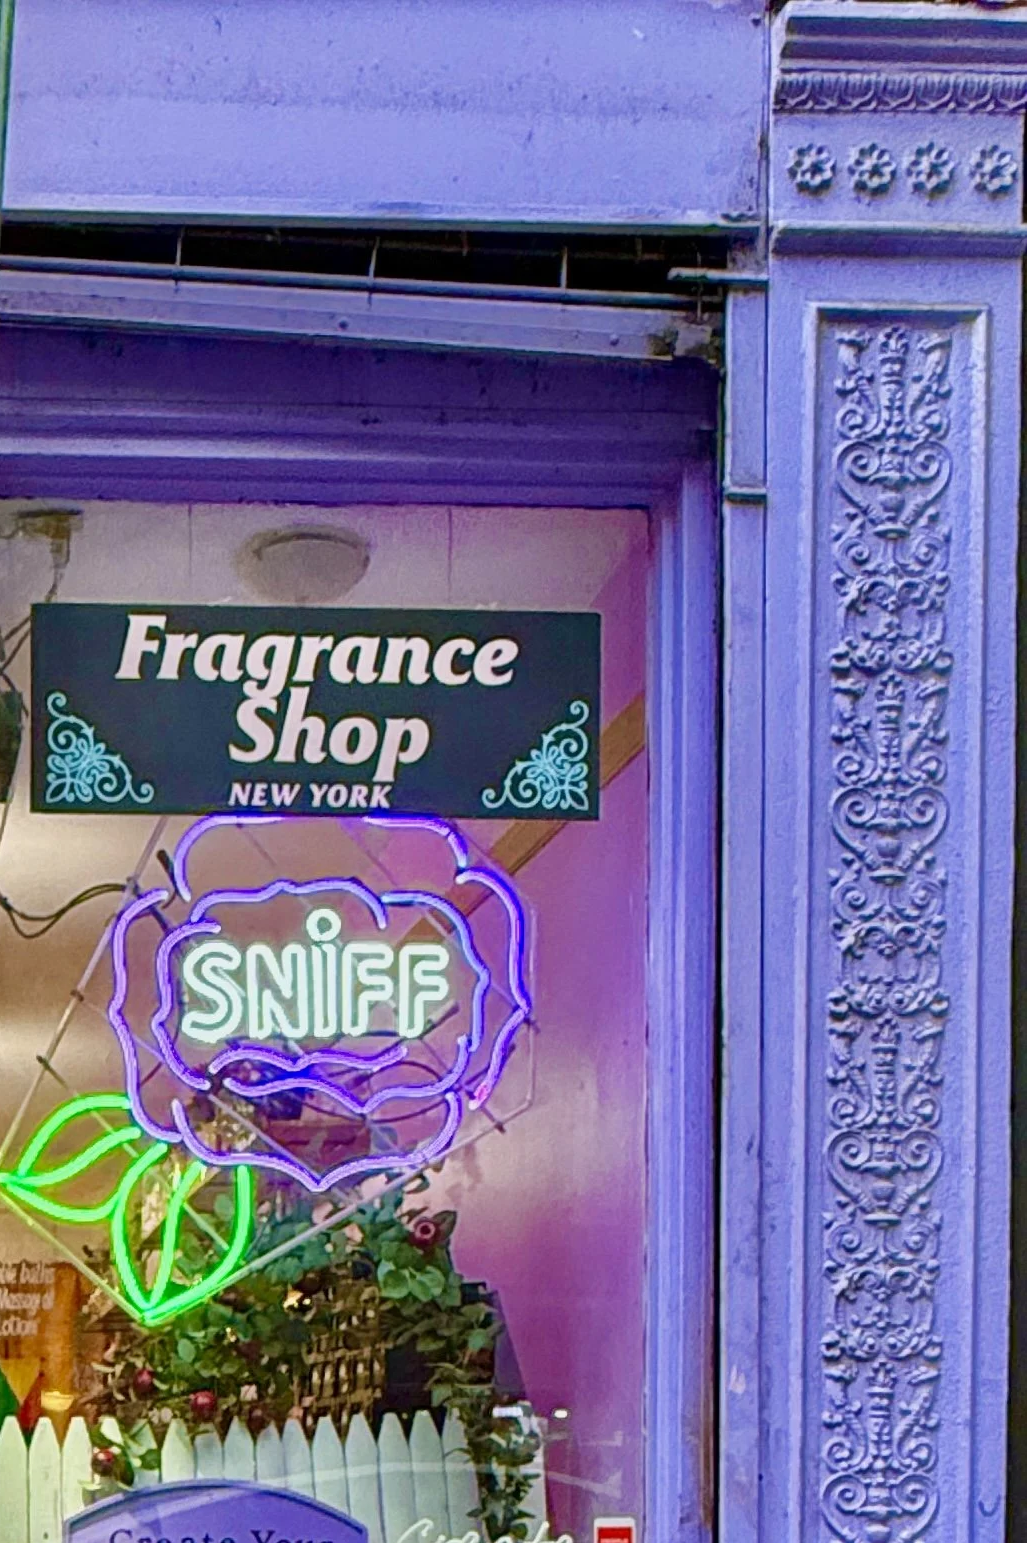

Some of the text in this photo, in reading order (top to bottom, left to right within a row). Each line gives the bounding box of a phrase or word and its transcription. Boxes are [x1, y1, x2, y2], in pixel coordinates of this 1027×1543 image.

[115, 613, 519, 698] Fragrance
[228, 686, 430, 782] Shop
[228, 781, 391, 808] NEW YORK
